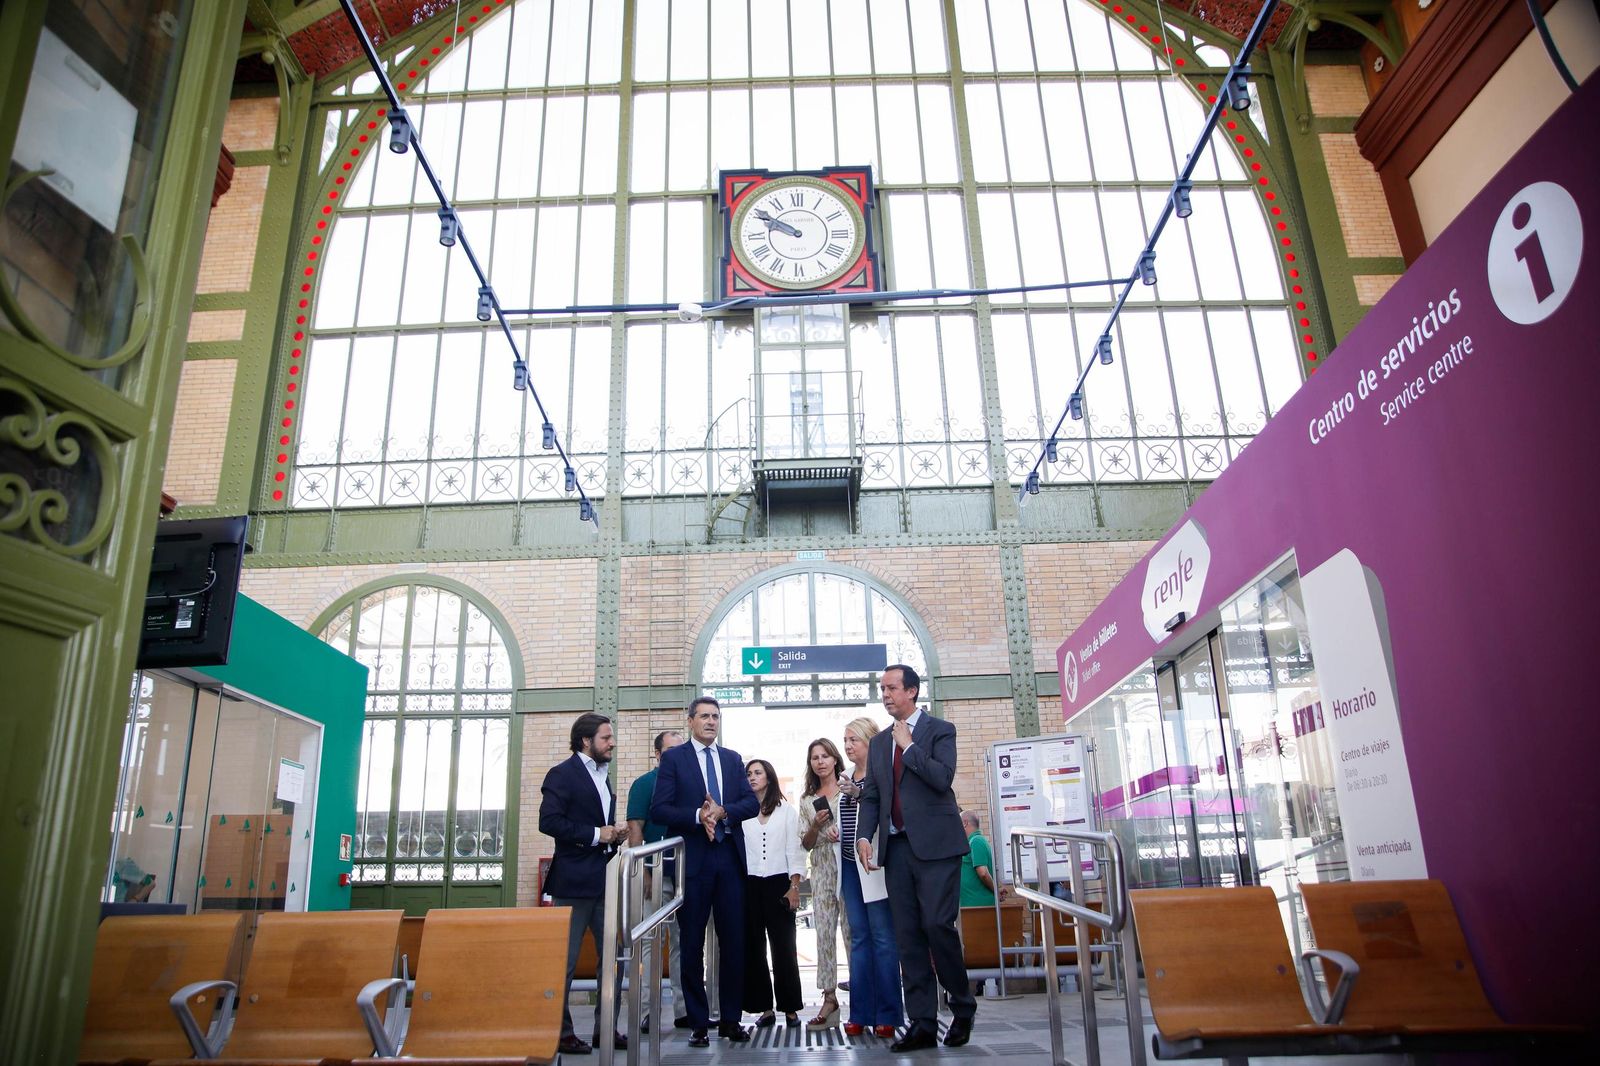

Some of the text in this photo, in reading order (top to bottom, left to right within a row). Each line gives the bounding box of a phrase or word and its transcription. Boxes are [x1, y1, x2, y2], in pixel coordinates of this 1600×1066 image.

[1309, 287, 1462, 445] Centro de servicios
[1380, 334, 1474, 426] Service centre
[798, 552, 823, 560] SALIDA
[1154, 549, 1193, 609] renfe
[778, 650, 807, 661] Salida
[1079, 621, 1118, 663] Venta de billetes
[716, 690, 742, 698] SALIDA
[1332, 687, 1377, 720] Horario
[1340, 738, 1390, 762] Centro de viajes
[1356, 839, 1412, 856] Venta anticipada
